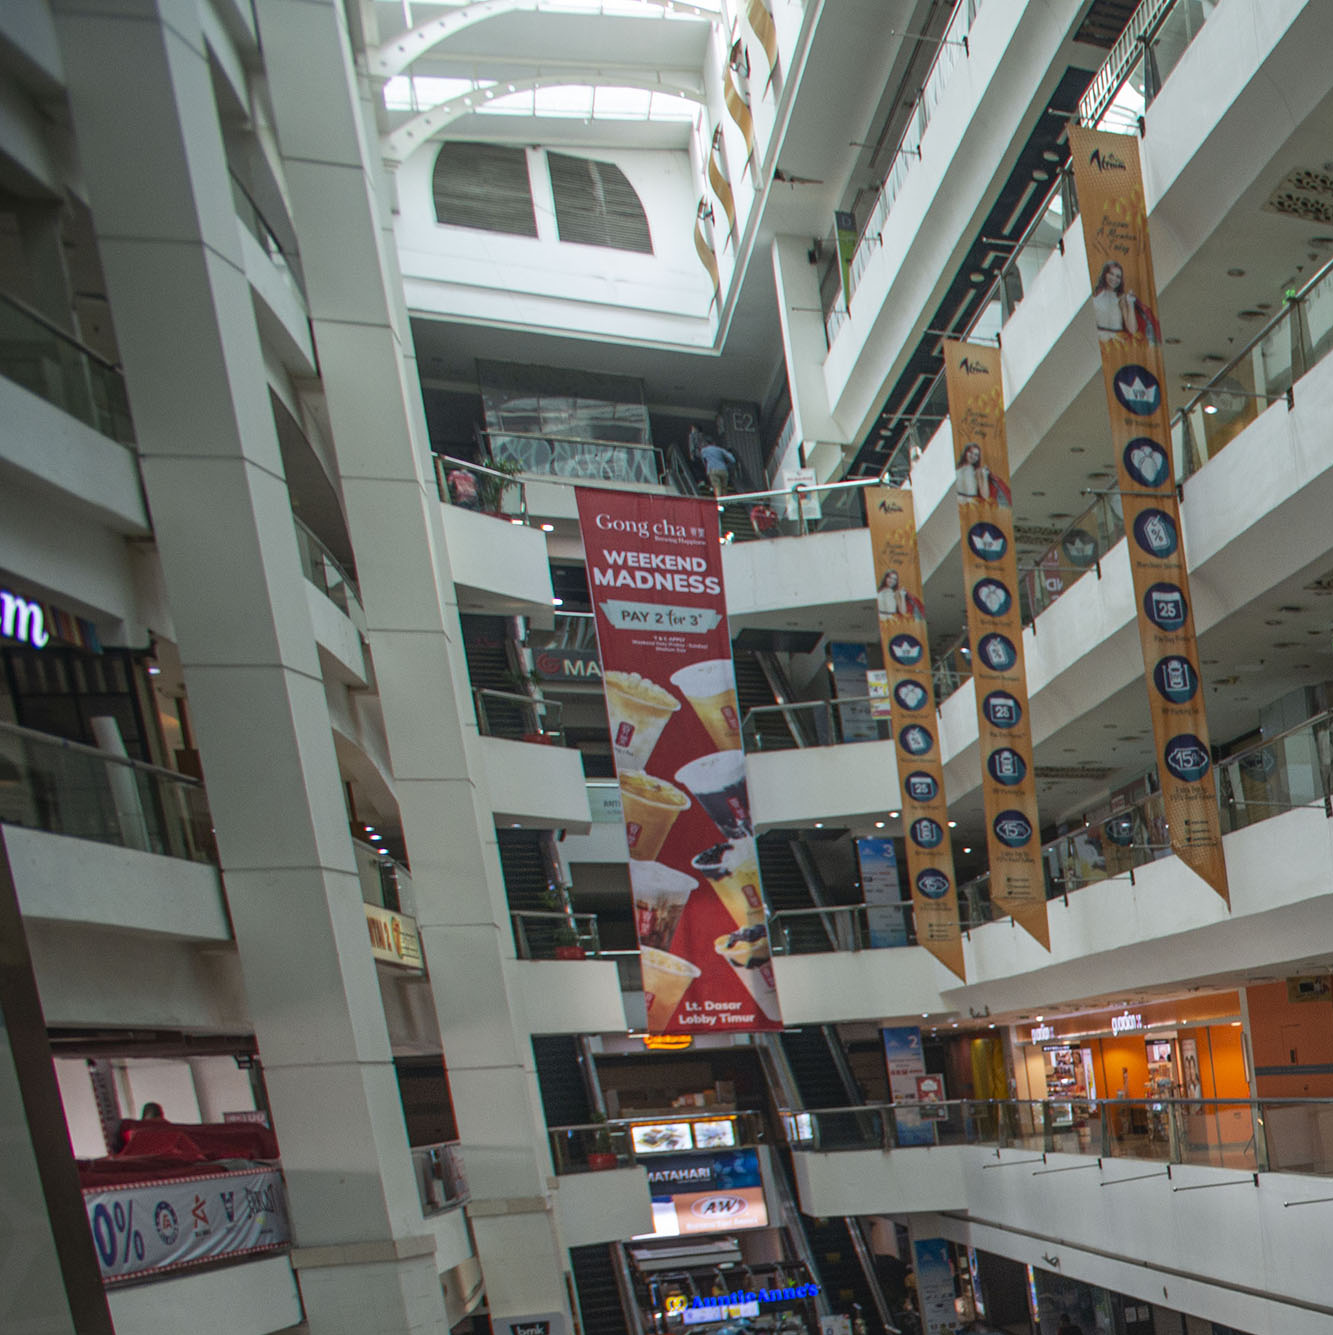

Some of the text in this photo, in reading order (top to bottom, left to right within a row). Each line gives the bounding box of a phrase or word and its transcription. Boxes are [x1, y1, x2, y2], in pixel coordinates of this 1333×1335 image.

[596, 513, 650, 538] Gong
[653, 519, 687, 537] cha
[603, 549, 708, 573] WEEKEND
[593, 566, 721, 595] MADNESS
[621, 610, 649, 623] PAY
[655, 612, 664, 624] 2
[668, 609, 686, 626] for
[1158, 602, 1177, 618] 25
[704, 1000, 742, 1011] Dasar
[678, 1013, 756, 1026] Lobby Timur
[907, 1035, 919, 1049] 2
